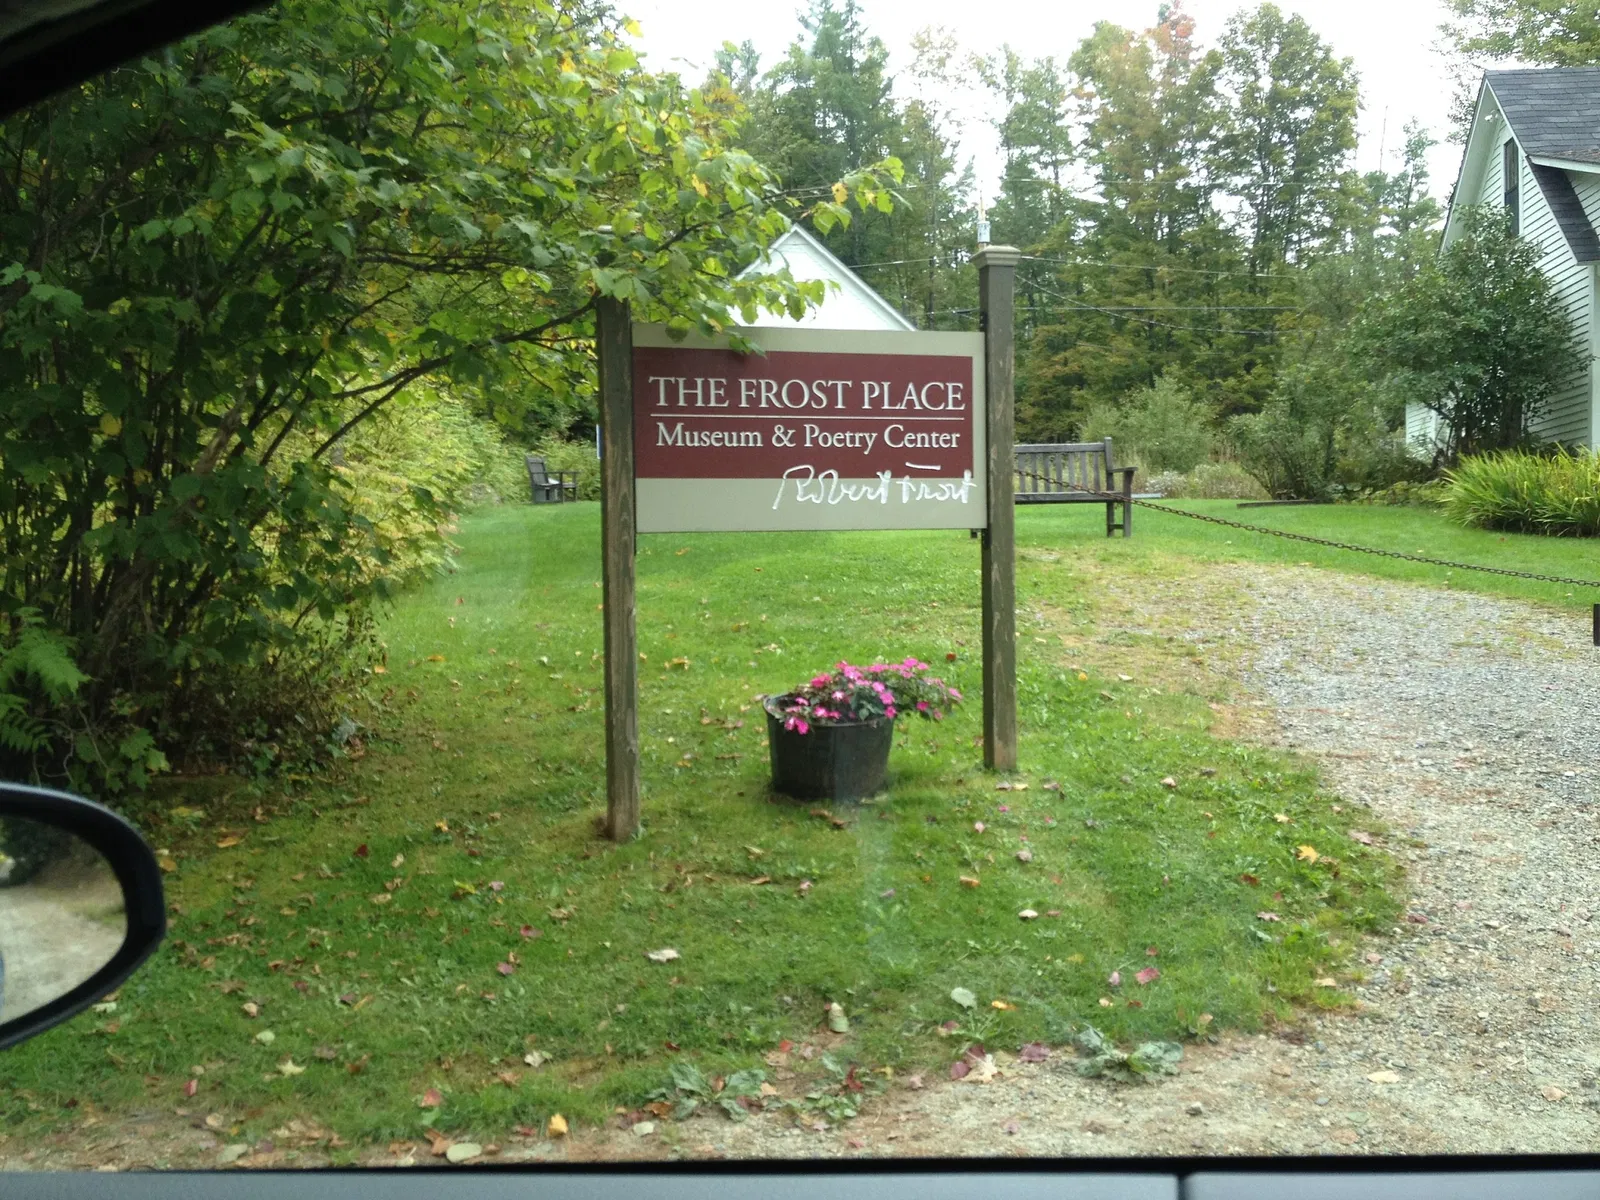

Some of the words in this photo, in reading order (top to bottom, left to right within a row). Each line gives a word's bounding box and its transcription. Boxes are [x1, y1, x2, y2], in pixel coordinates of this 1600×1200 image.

[648, 376, 729, 407] THE
[738, 379, 852, 410] FROST
[862, 381, 966, 411] PLACE
[656, 422, 764, 448] Museum
[771, 424, 796, 448] &
[803, 424, 878, 455] Poetry
[884, 424, 960, 448] Center
[772, 464, 892, 510] Robert
